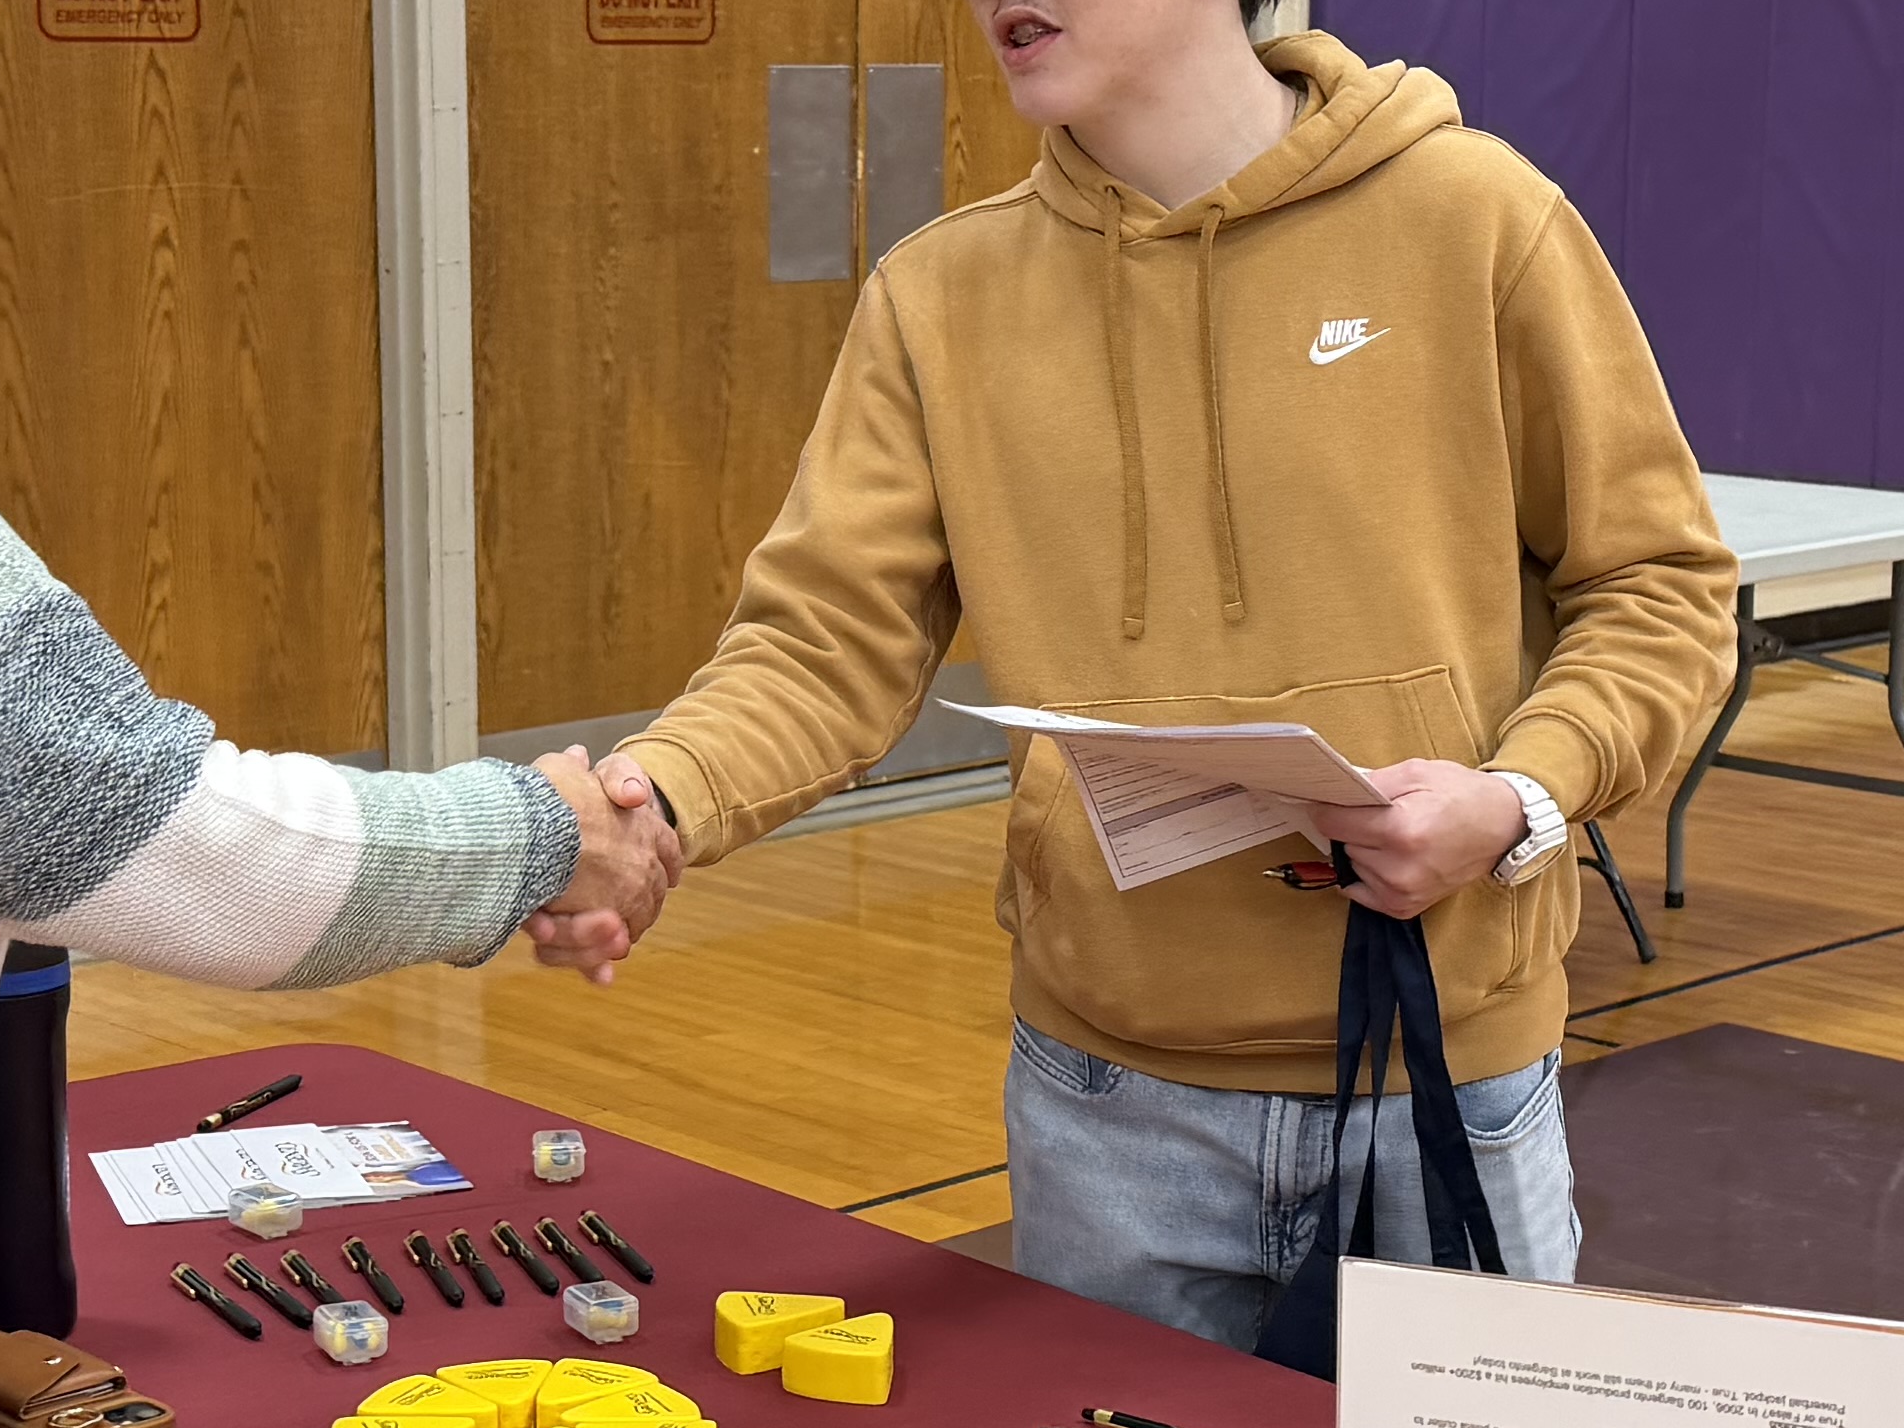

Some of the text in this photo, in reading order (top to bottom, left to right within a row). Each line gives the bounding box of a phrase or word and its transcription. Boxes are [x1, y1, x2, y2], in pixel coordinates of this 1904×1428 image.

[1319, 318, 1371, 347] NIKE
[1508, 1358, 1557, 1377] Sargento
[1511, 1372, 1569, 1392] employees
[1575, 1369, 1600, 1383] work
[1572, 1380, 1630, 1400] production
[1670, 1379, 1700, 1394] many
[1712, 1387, 1738, 1400] True
[1633, 1388, 1683, 1407] Sargento
[1687, 1398, 1707, 1411] 100
[1761, 1408, 1799, 1423] False?
[1818, 1416, 1845, 1428] True
